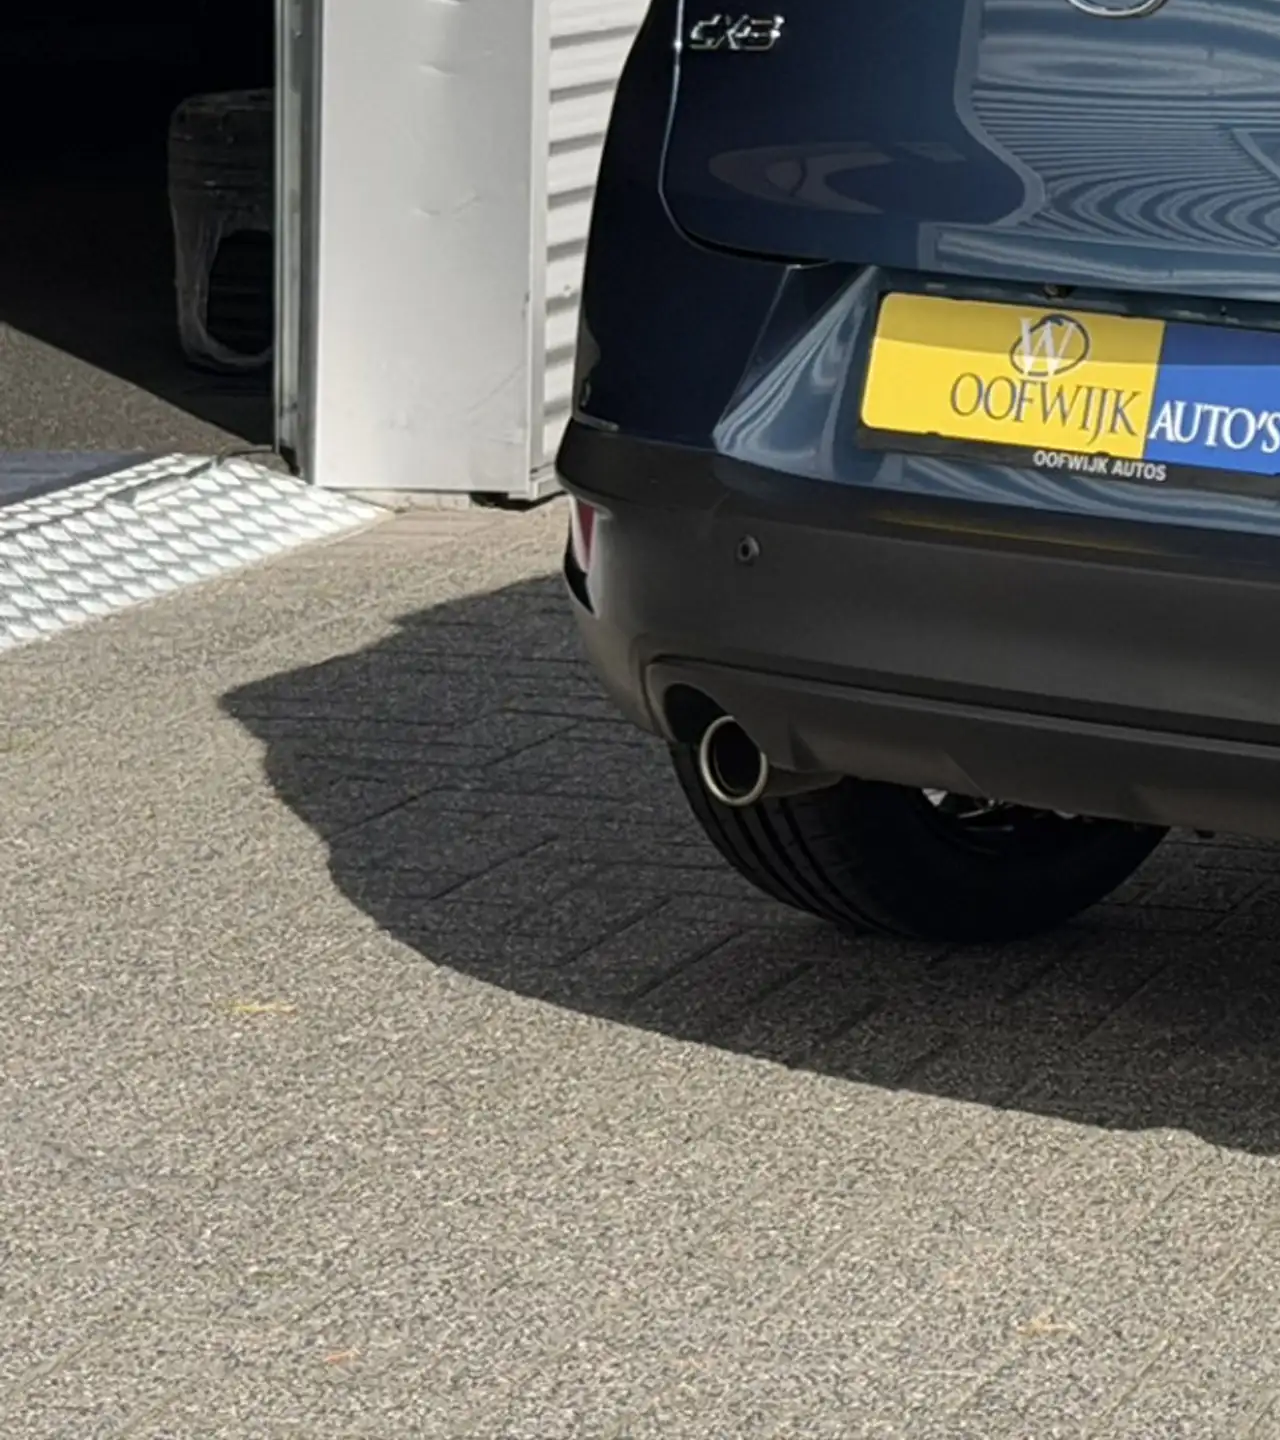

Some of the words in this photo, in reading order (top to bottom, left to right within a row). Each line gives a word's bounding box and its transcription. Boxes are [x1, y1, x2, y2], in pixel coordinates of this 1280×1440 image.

[950, 371, 1142, 447] OOFWIJK
[1032, 449, 1110, 475] OOFWIJK
[1111, 459, 1167, 482] AUTOS
